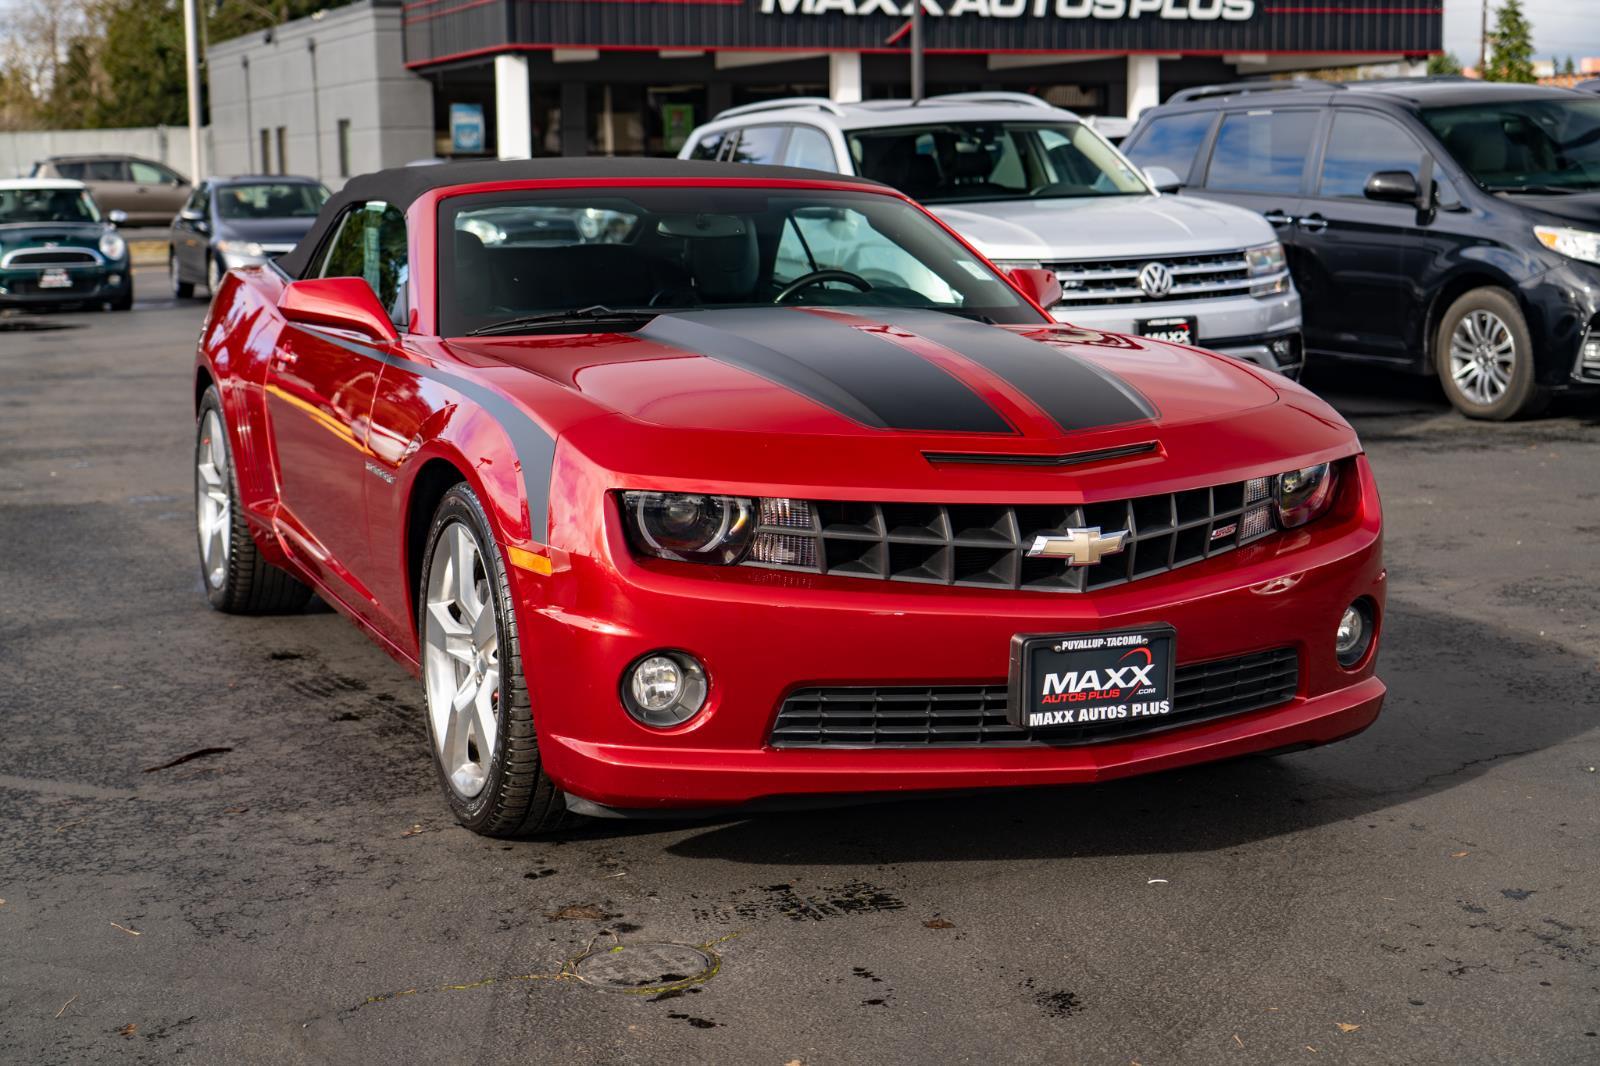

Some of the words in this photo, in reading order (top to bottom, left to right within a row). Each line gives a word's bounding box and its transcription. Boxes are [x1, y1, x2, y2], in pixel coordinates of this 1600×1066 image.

[1042, 664, 1156, 696] MAXX
[1041, 691, 1087, 704] AUTOS
[1088, 688, 1121, 700] PLUS
[1029, 709, 1075, 727] MAXX
[1078, 704, 1127, 722] AUTOS
[1131, 700, 1170, 717] PLUS
